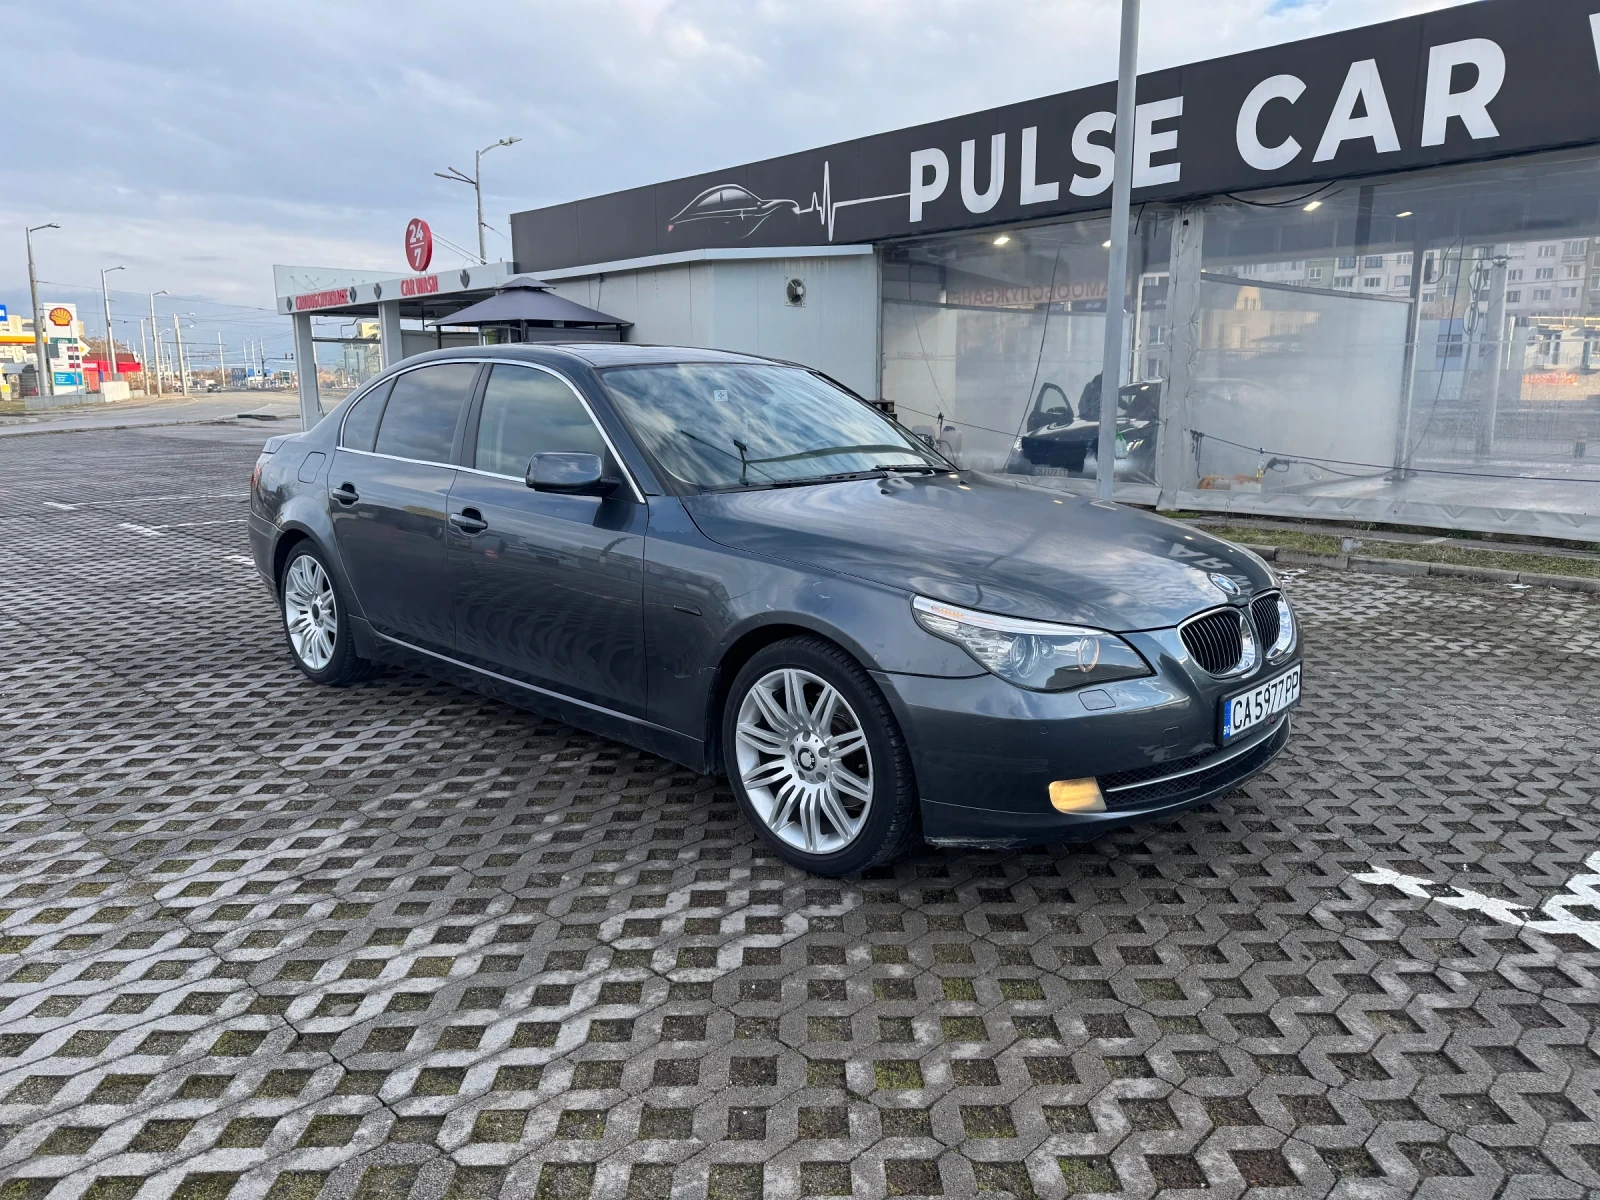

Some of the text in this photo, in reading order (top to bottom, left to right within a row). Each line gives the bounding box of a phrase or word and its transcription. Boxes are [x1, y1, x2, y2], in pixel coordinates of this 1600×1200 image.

[908, 96, 1184, 223] PULSE
[1235, 38, 1507, 171] CAR
[409, 222, 424, 243] 24
[414, 247, 422, 267] 7
[400, 275, 438, 296] CAR WASH
